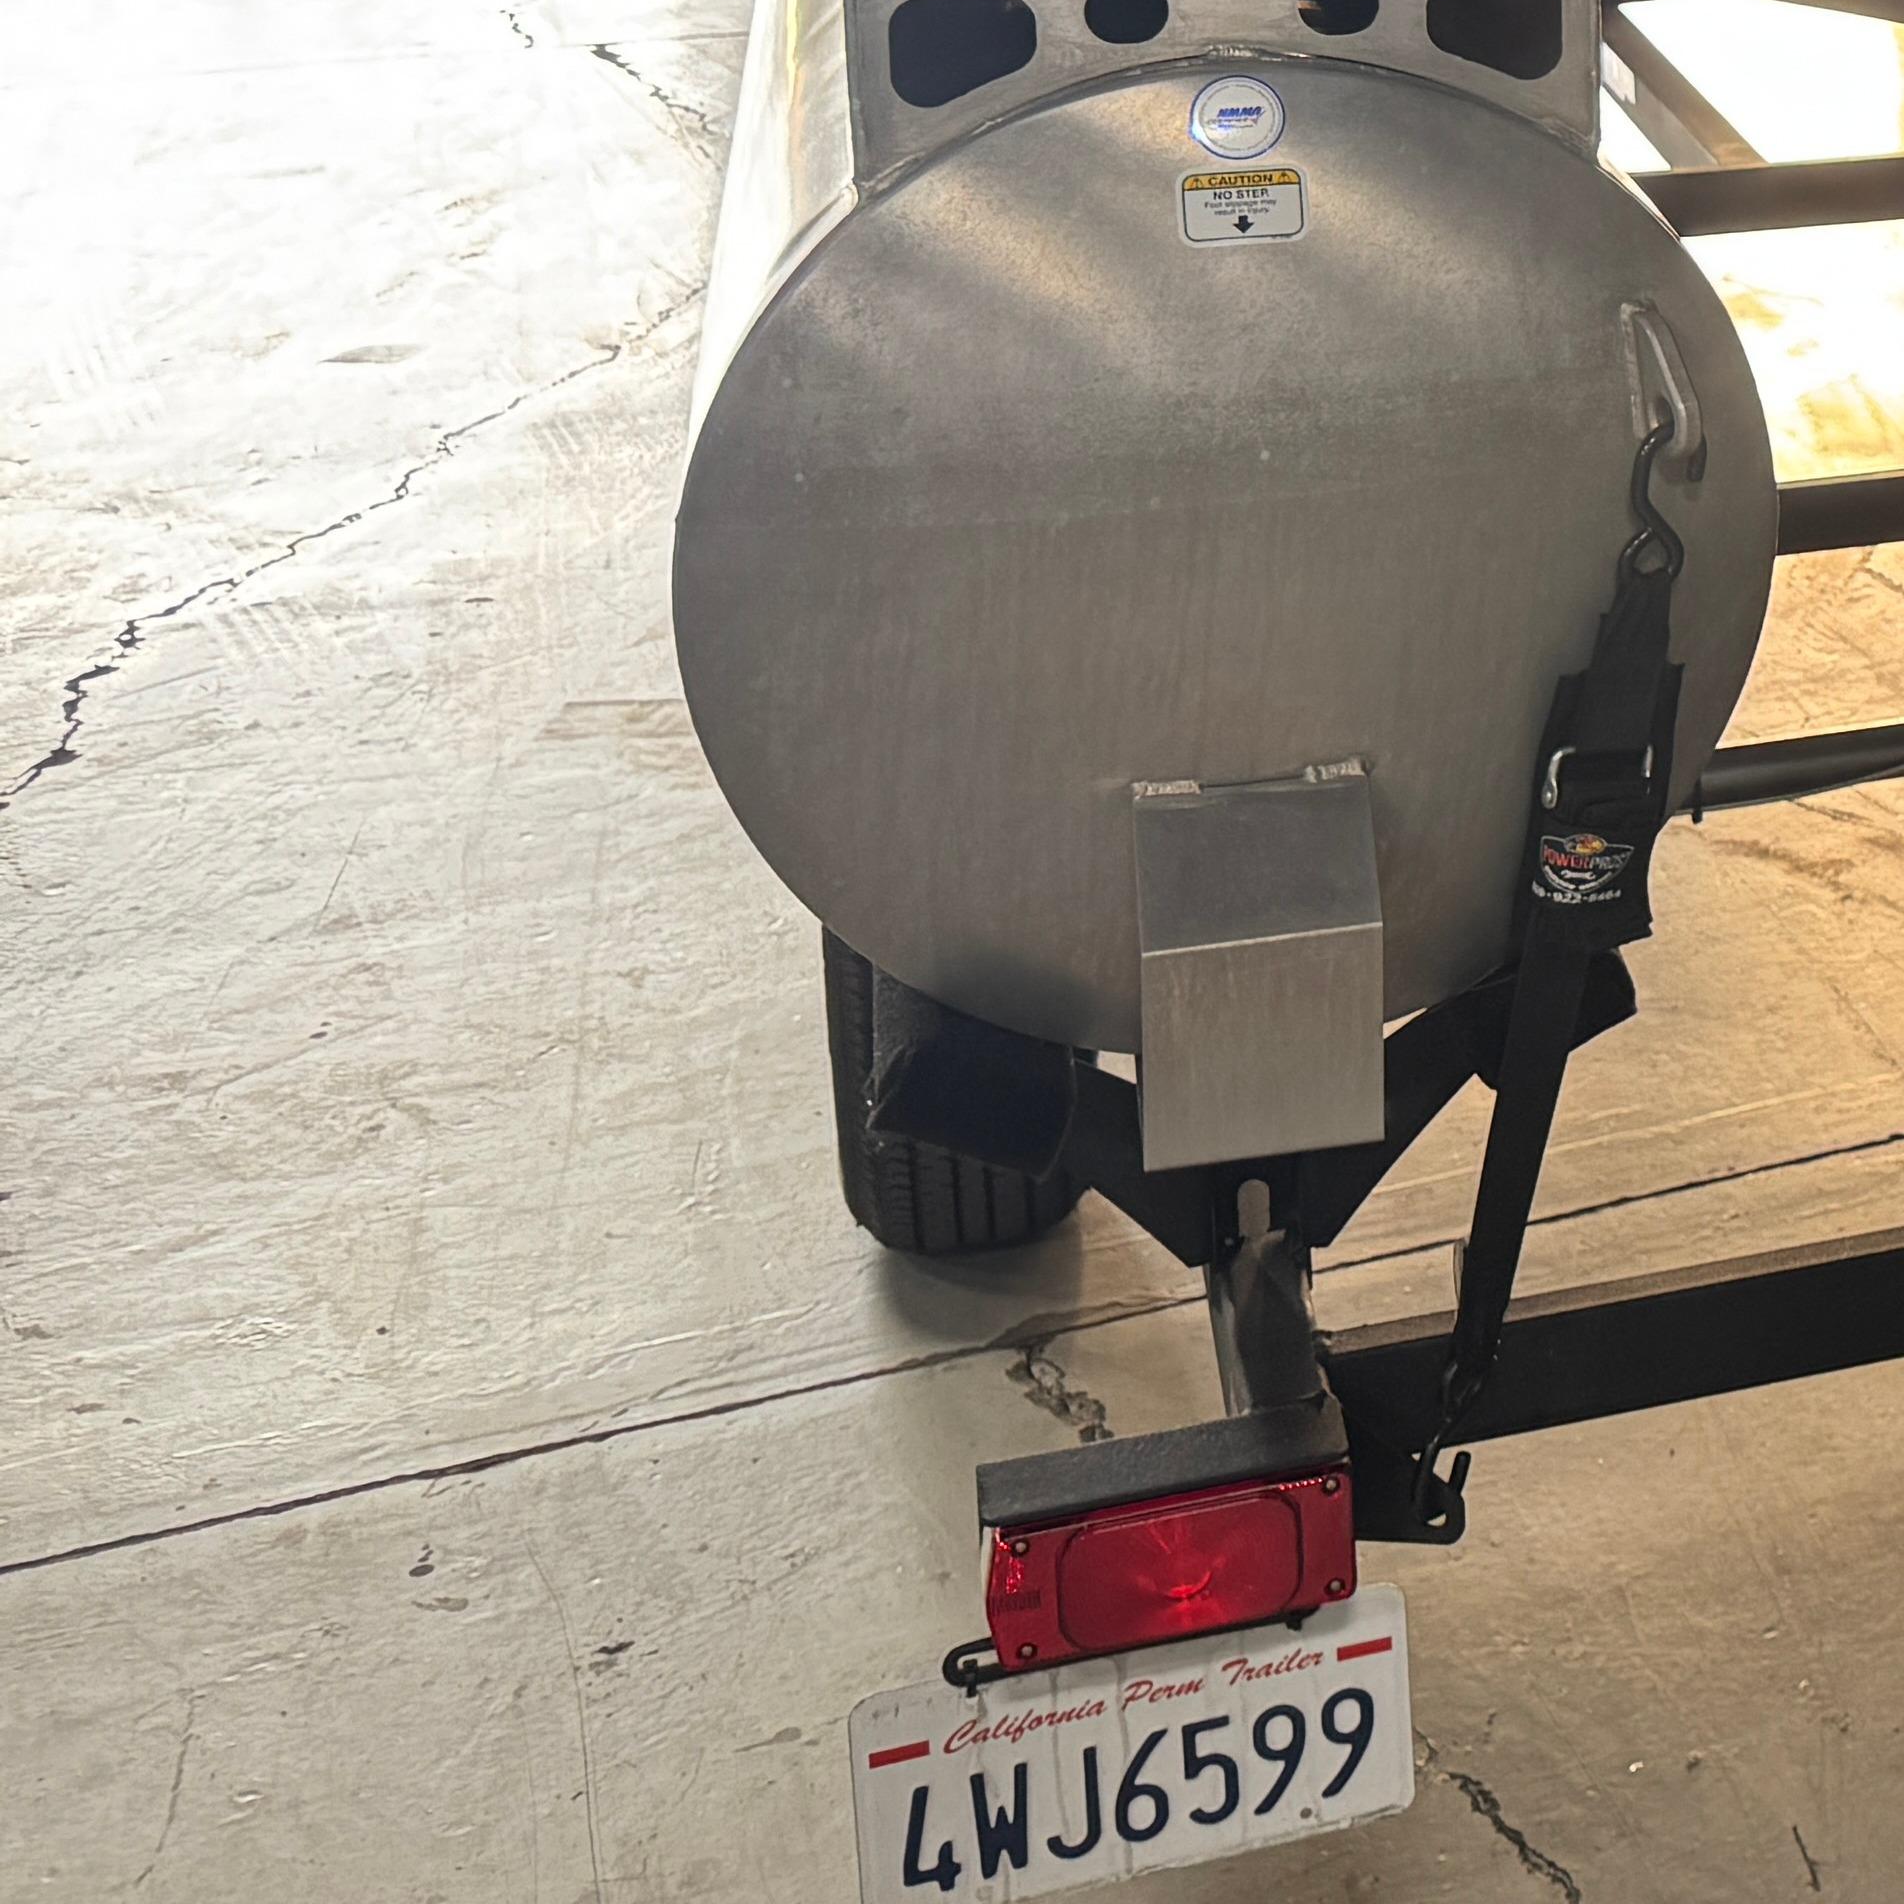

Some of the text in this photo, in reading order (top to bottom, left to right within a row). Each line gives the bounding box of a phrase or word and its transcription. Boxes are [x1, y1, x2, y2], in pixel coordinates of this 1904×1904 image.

[1207, 174, 1273, 187] CAUTION
[1213, 190, 1233, 201] NO
[943, 1647, 1324, 1755] California Perm Trailer
[903, 1687, 1375, 1892] 4WJ6599
